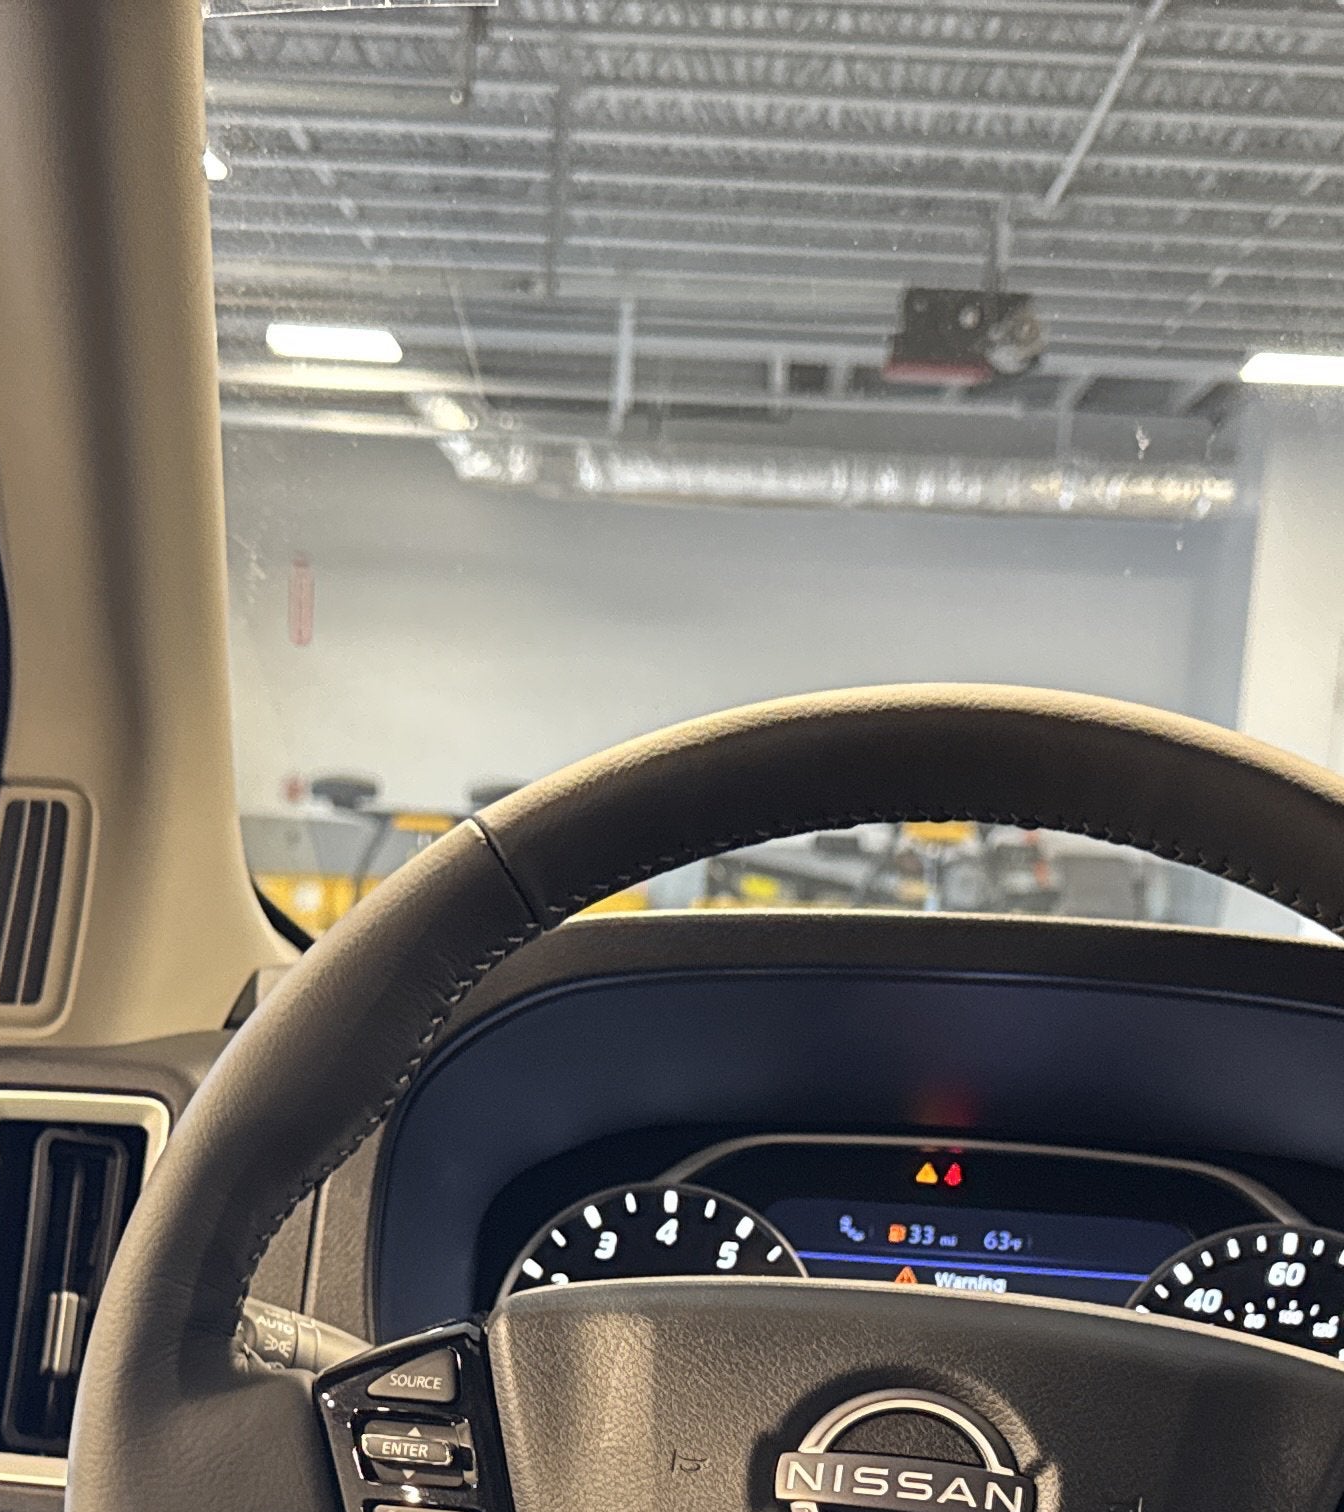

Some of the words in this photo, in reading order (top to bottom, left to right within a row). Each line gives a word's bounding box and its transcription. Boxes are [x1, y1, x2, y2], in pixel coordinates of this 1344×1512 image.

[655, 1218, 679, 1246] 4
[908, 1223, 936, 1245] 33
[594, 1231, 618, 1260] 3
[716, 1240, 739, 1270] 5
[934, 1271, 1007, 1294] Warning
[1267, 1261, 1306, 1288] 60
[1183, 1287, 1223, 1314] 40
[255, 1314, 296, 1336] AUTO
[389, 1374, 443, 1390] SOURCE
[381, 1441, 429, 1458] ENTER
